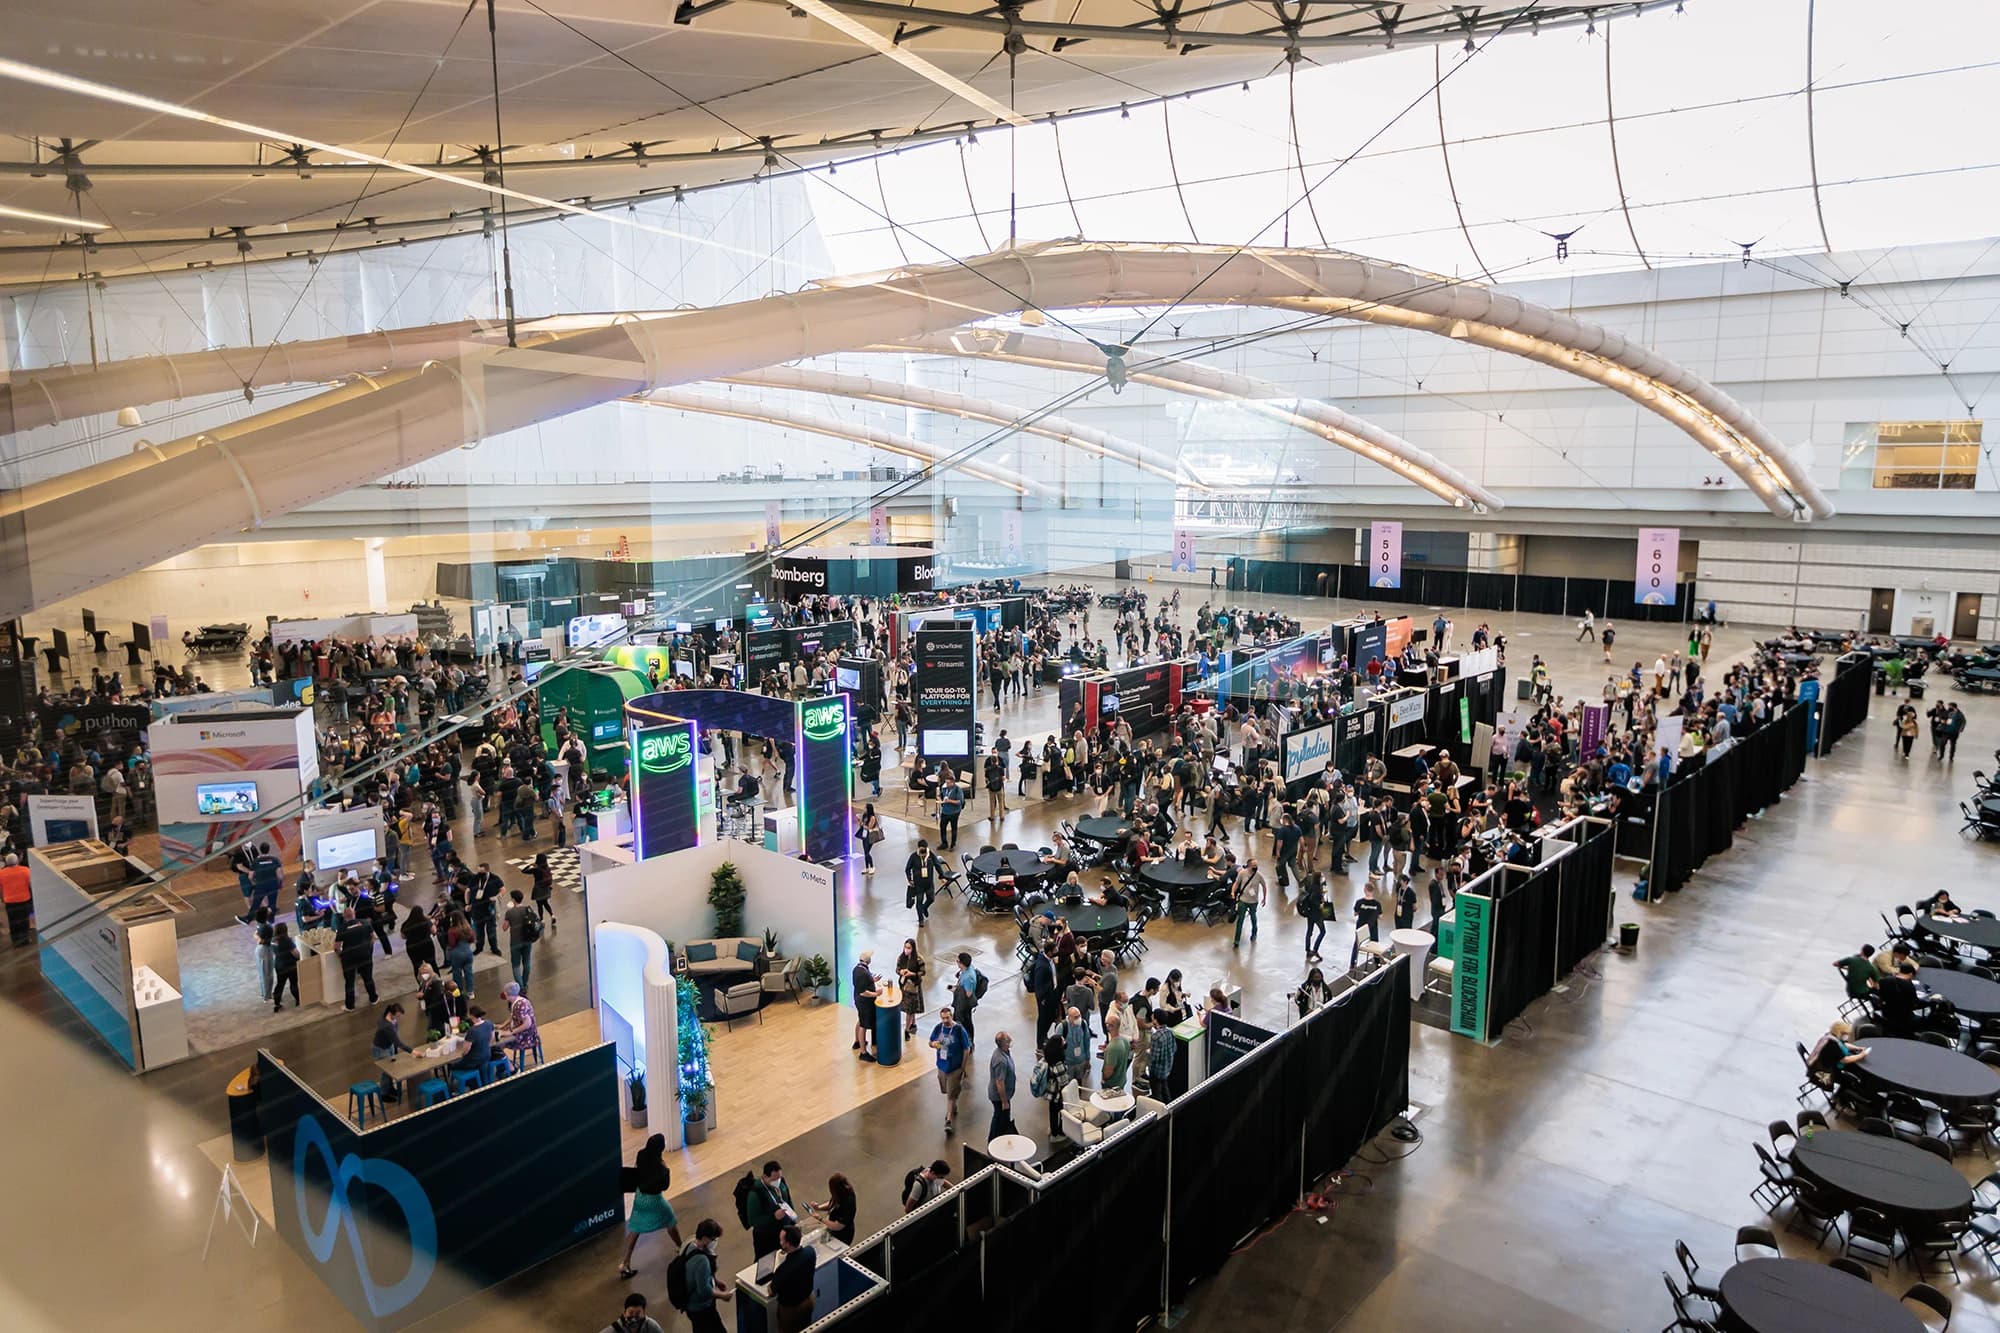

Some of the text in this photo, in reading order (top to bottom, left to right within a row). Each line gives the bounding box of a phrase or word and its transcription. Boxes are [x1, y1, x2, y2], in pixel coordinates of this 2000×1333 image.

[1381, 539, 1390, 574] 500
[1650, 549, 1662, 588] 600
[84, 712, 138, 732] python
[804, 705, 844, 729] aws
[212, 730, 247, 740] Microsoft
[642, 732, 690, 758] aws
[1287, 731, 1330, 778] pyladies
[810, 874, 826, 886] Meta
[1462, 919, 1480, 956] PYTHON
[1462, 956, 1479, 975] FOR
[1460, 975, 1478, 1032] BLOCKCHAIN
[588, 1208, 615, 1227] Meta
